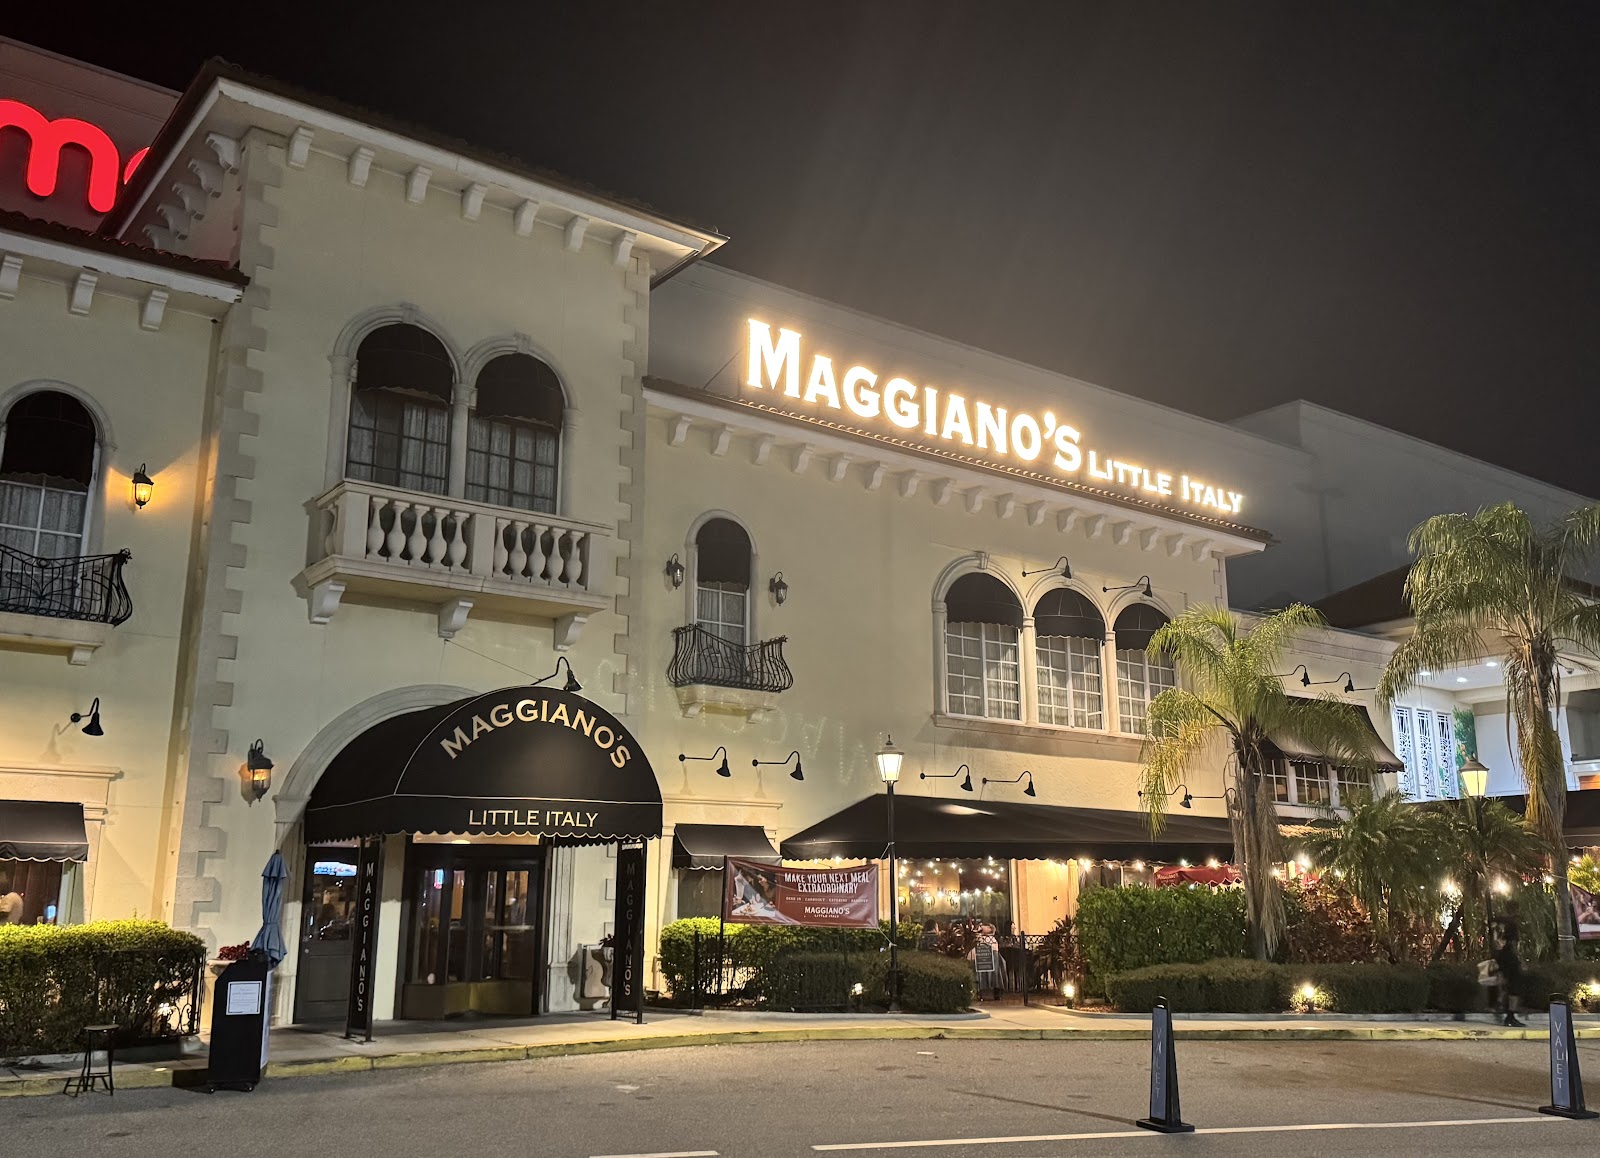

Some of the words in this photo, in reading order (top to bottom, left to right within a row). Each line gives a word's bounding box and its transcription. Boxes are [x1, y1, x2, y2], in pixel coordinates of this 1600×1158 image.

[746, 317, 1083, 473] MAGGIANO'S
[1088, 450, 1172, 497] LITTLE
[1181, 474, 1244, 513] ITALY
[439, 699, 633, 769] MAGGIANO'S
[468, 809, 540, 826] LITTLE
[545, 810, 599, 828] ITALY
[784, 872, 806, 883] MAKE
[807, 873, 828, 883] YOUR
[829, 873, 849, 883] NEXT
[850, 871, 870, 883] MEAL
[797, 882, 859, 894] EXTRAORDINARY
[623, 862, 636, 996] MAGGIANO'S
[804, 906, 851, 915] MAGGIANO'S
[357, 862, 375, 1012] MAGGIANO'S
